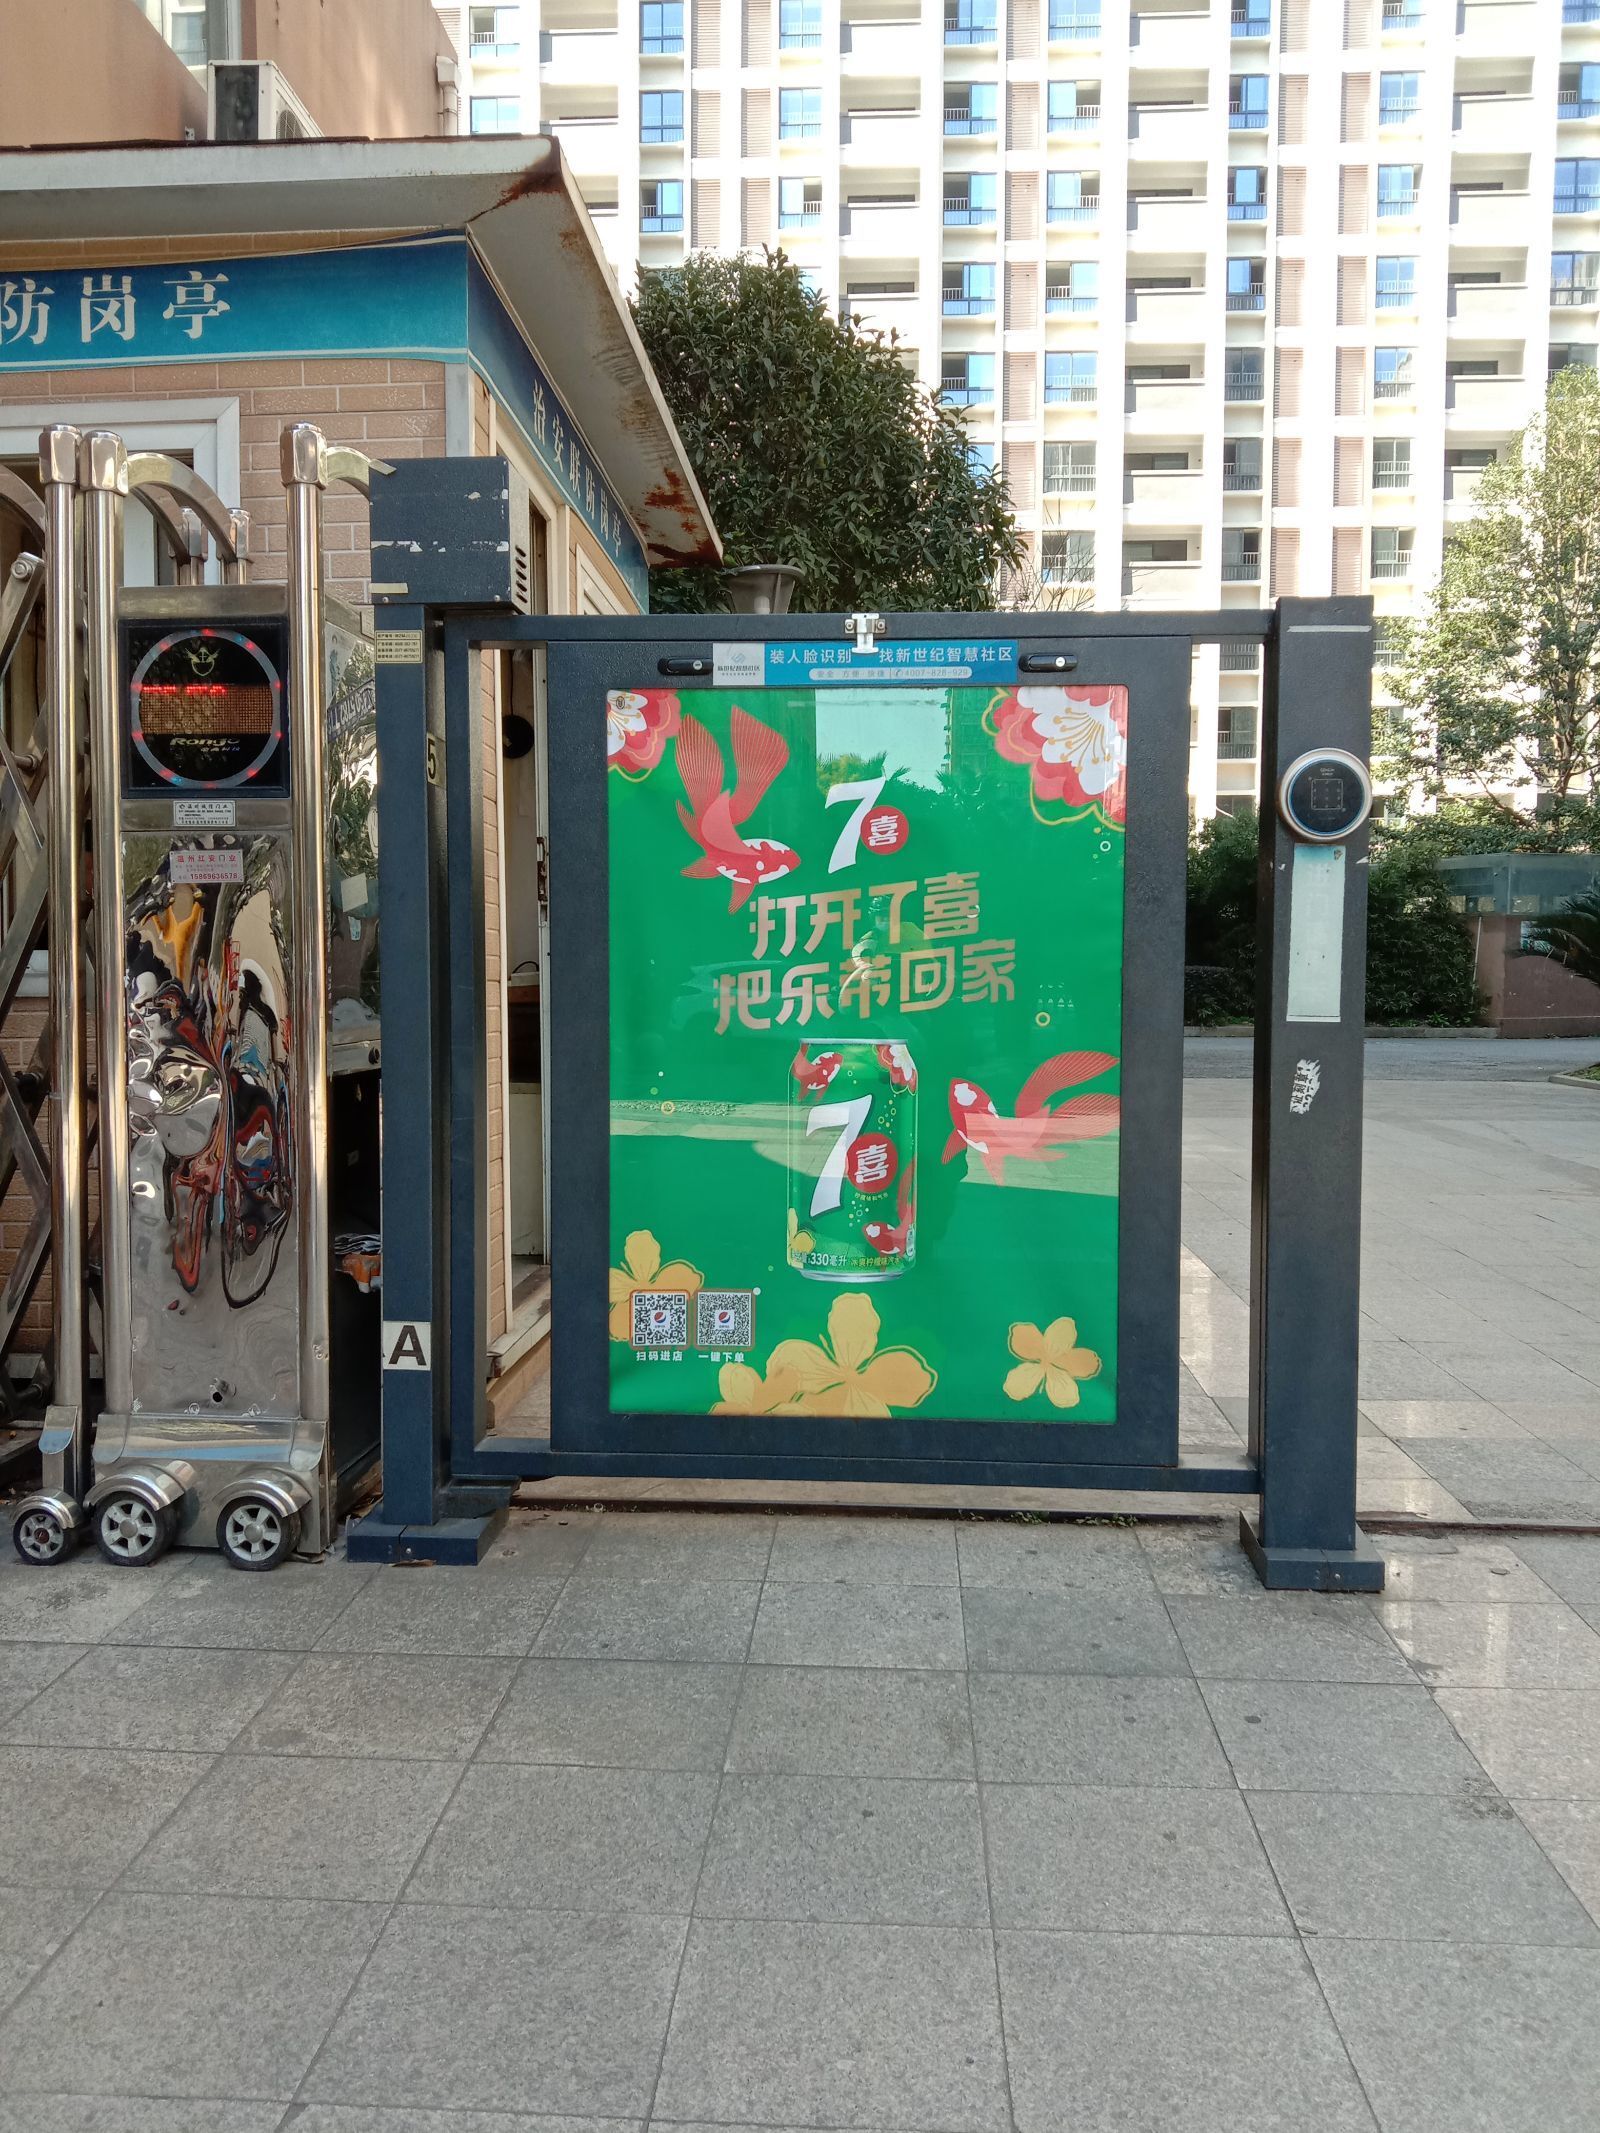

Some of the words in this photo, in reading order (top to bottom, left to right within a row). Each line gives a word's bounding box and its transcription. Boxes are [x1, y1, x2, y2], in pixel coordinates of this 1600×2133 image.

[0, 270, 231, 345] 防岗亭
[532, 378, 622, 558] 治安联防岗亭
[769, 648, 851, 664] 装人脸识别
[878, 646, 1013, 663] 找新世纪智慧社区
[427, 738, 436, 780] 5
[749, 872, 980, 960] 打开了喜
[713, 938, 1017, 1036] 把乐带回家
[388, 1324, 427, 1366] A
[636, 1351, 683, 1362] 扫码进店
[698, 1352, 745, 1363] 一键下单
